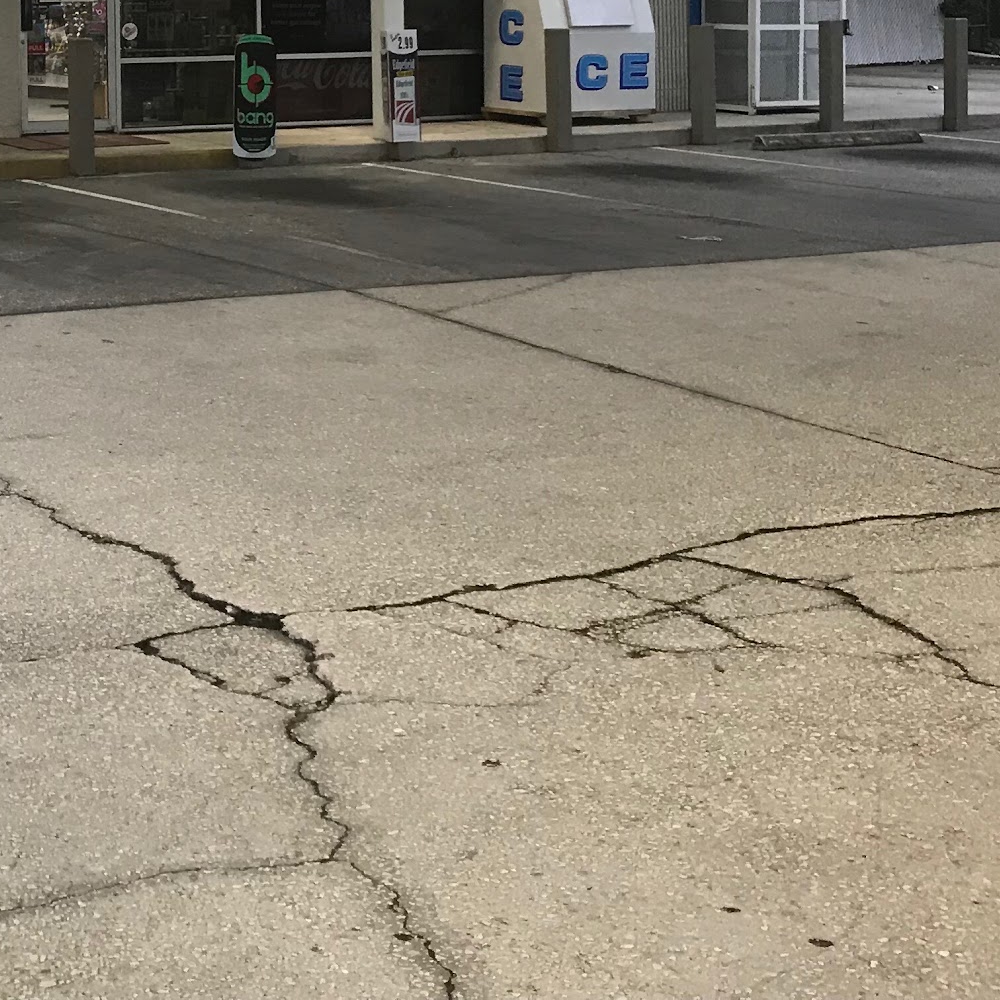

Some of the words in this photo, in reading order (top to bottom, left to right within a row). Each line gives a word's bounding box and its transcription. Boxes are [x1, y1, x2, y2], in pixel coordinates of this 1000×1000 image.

[398, 36, 414, 50] 2.99
[576, 52, 650, 92] CE
[236, 107, 275, 128] bang
